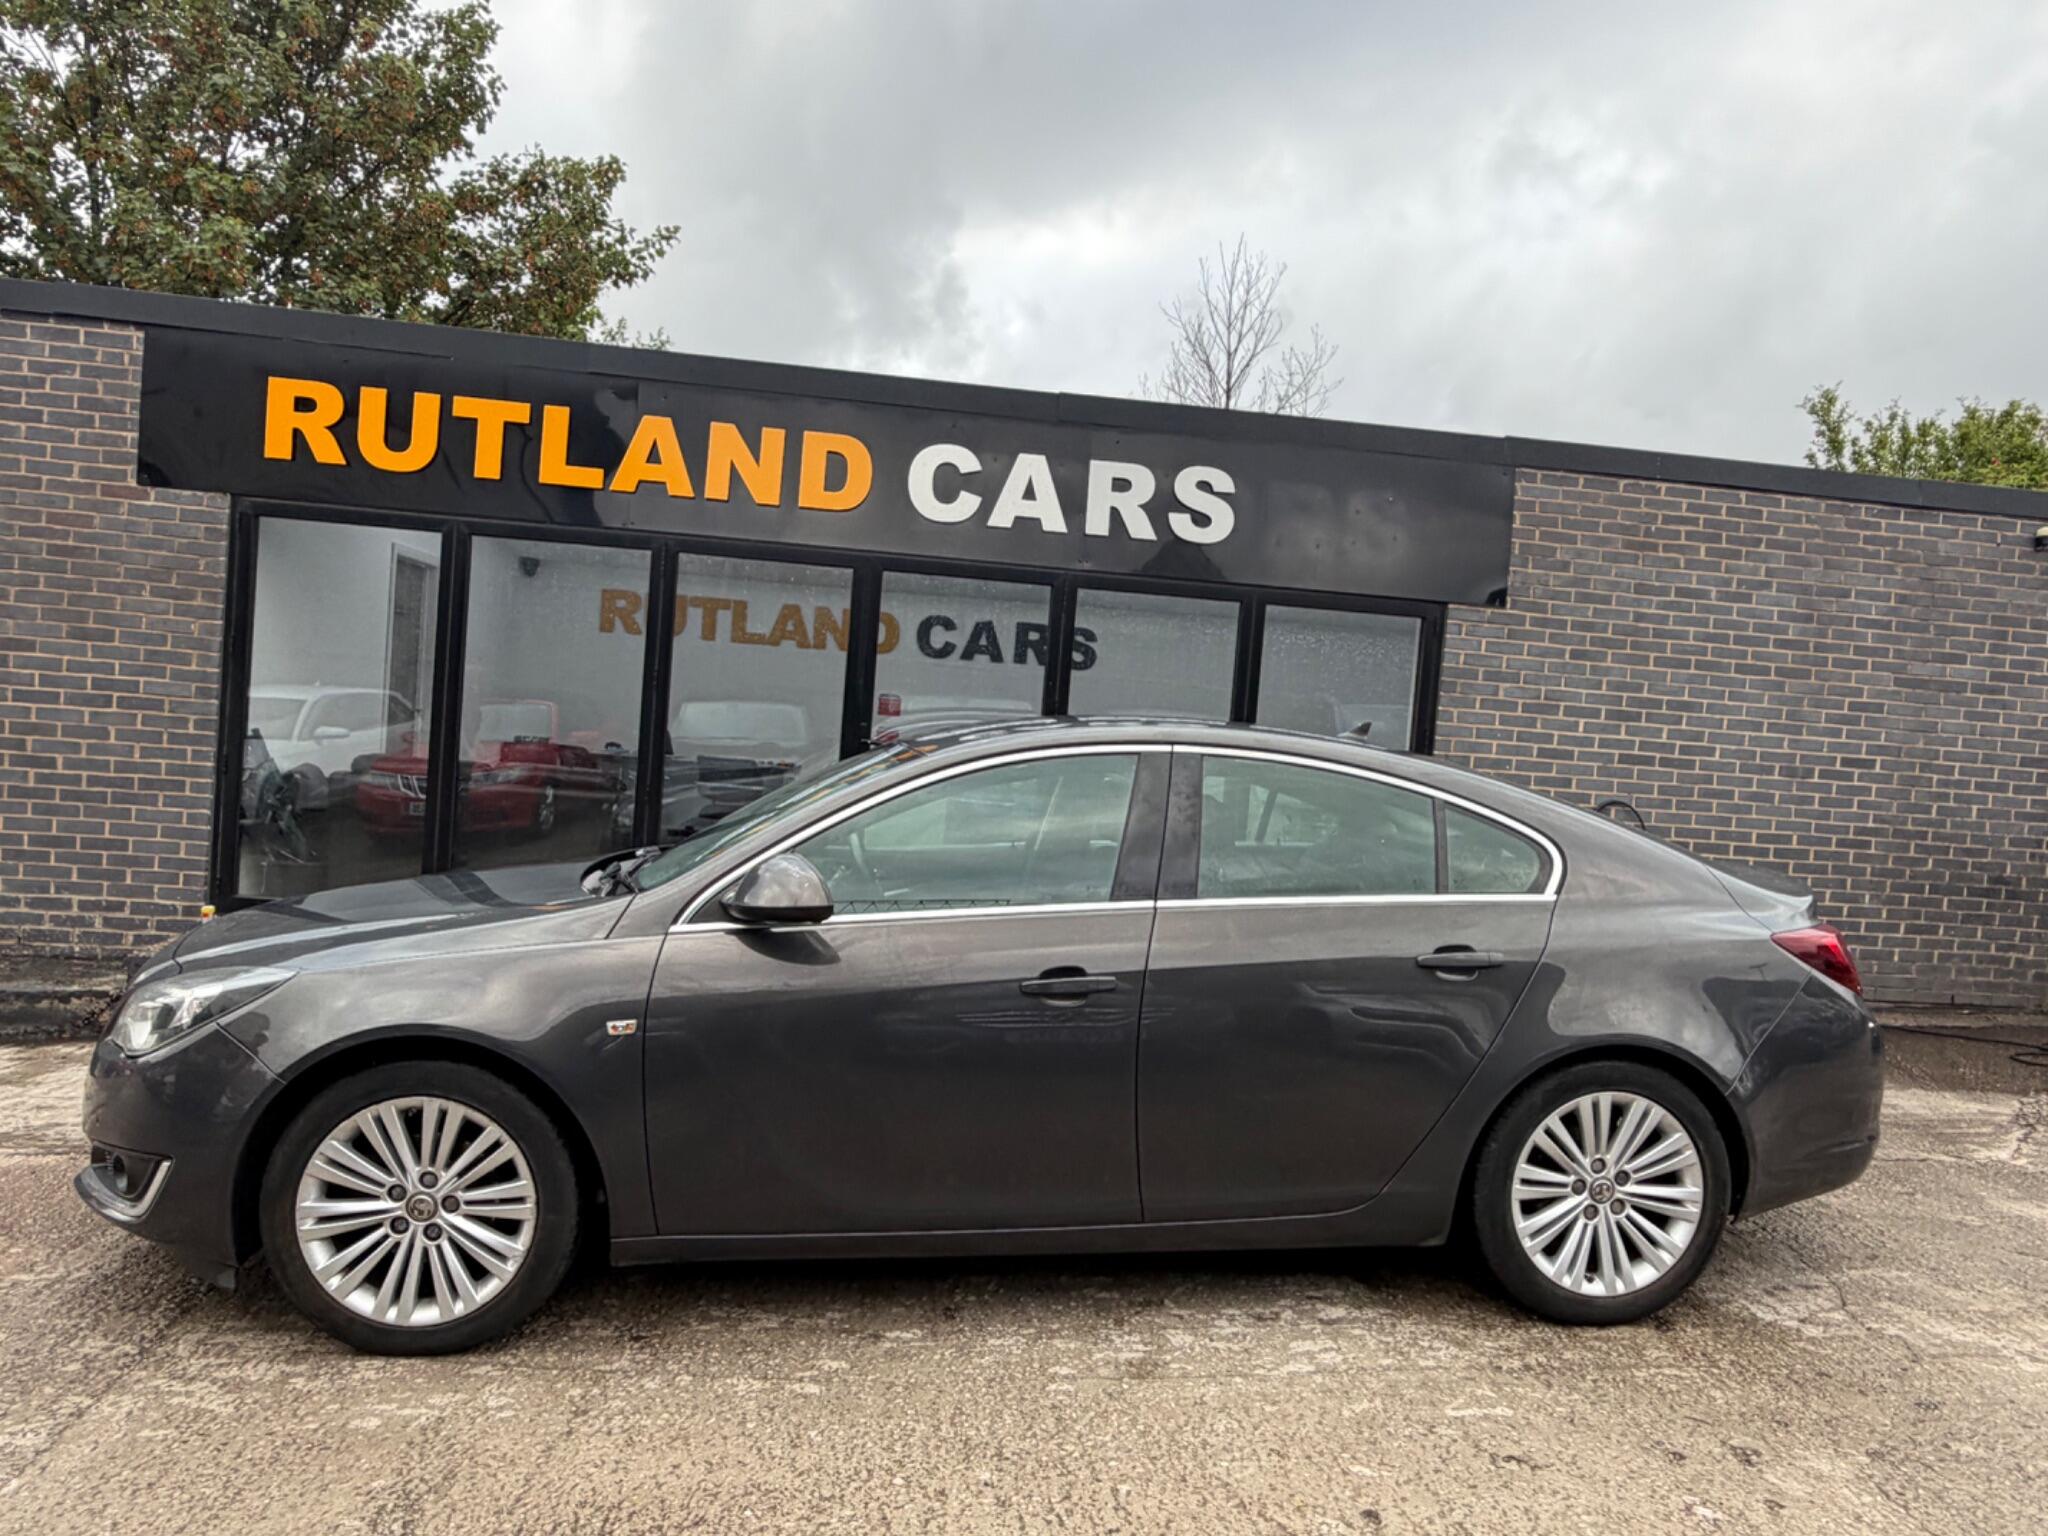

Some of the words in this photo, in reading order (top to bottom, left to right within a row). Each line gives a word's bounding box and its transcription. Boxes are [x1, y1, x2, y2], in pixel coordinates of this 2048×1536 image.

[263, 376, 873, 512] RUTLAND
[908, 443, 1236, 545] CARS
[916, 614, 1098, 671] CARS
